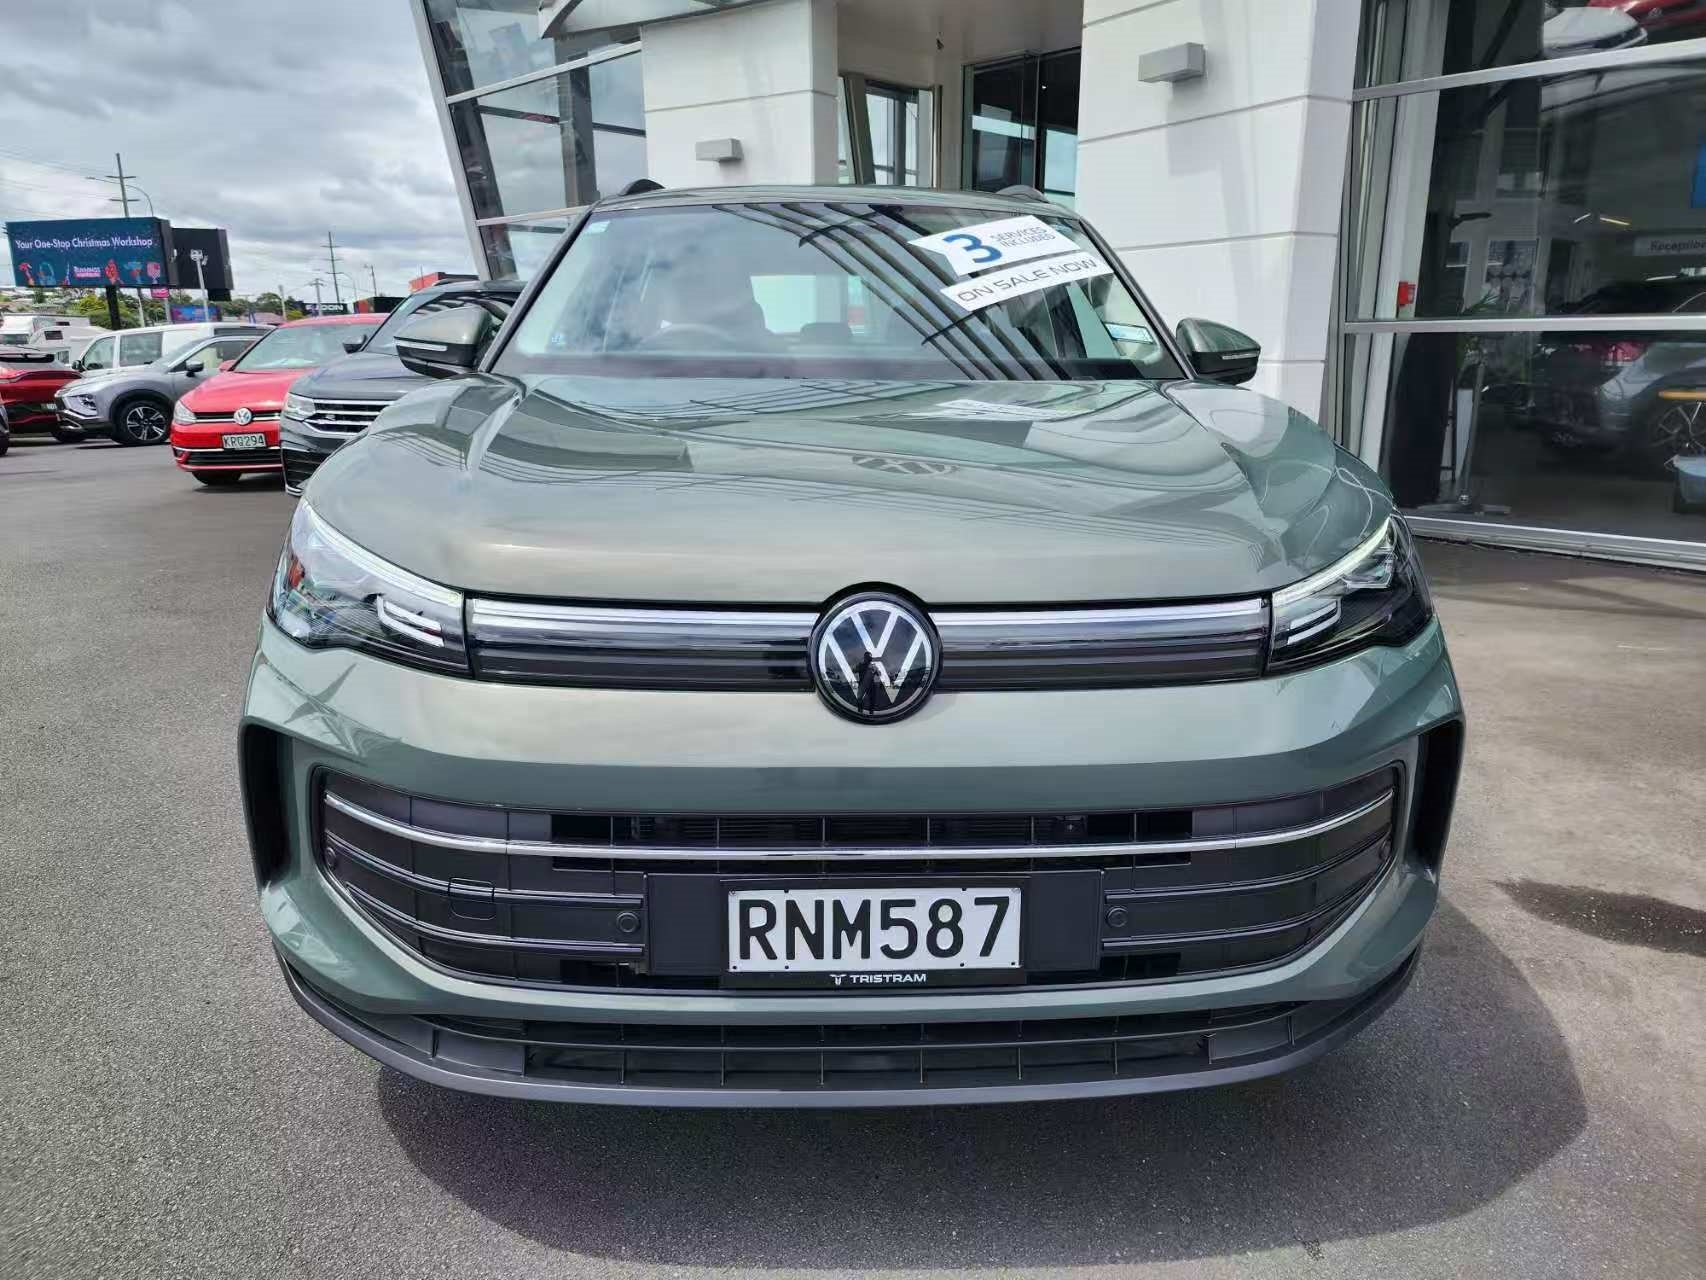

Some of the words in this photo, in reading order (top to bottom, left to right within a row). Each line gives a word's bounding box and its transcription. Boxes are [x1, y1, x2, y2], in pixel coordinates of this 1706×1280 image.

[990, 226, 1048, 242] SERVICES
[1000, 234, 1056, 248] INCLUDED
[15, 240, 33, 249] Your
[34, 238, 71, 249] One-Stop
[72, 237, 111, 248] Christmas
[111, 236, 153, 248] Workshop
[943, 233, 1002, 263] 3
[958, 284, 994, 302] ON
[993, 269, 1049, 290] SALE
[1049, 259, 1097, 274] NOW
[223, 434, 265, 448] KRG294
[739, 896, 1010, 960] RNM587
[849, 974, 927, 984] TRISTRAM
